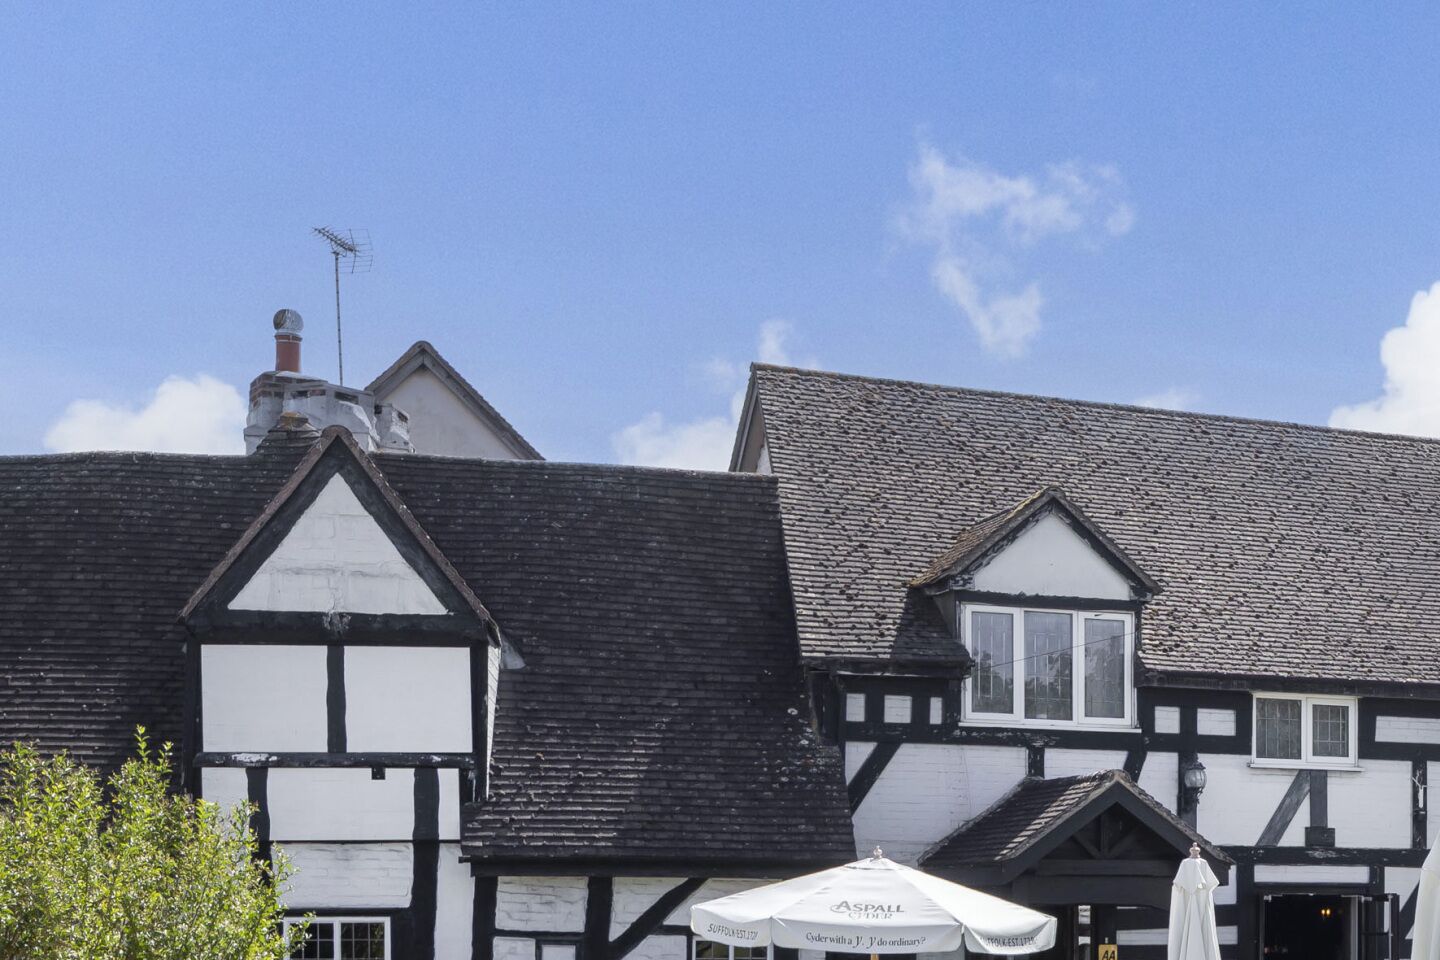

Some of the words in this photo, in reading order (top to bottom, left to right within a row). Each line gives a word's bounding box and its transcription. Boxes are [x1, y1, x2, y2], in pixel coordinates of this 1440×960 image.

[806, 931, 828, 943] Cyder
[829, 935, 846, 945] with
[877, 937, 888, 946] do
[888, 936, 926, 947] ordinary?
[1101, 950, 1116, 960] AA
